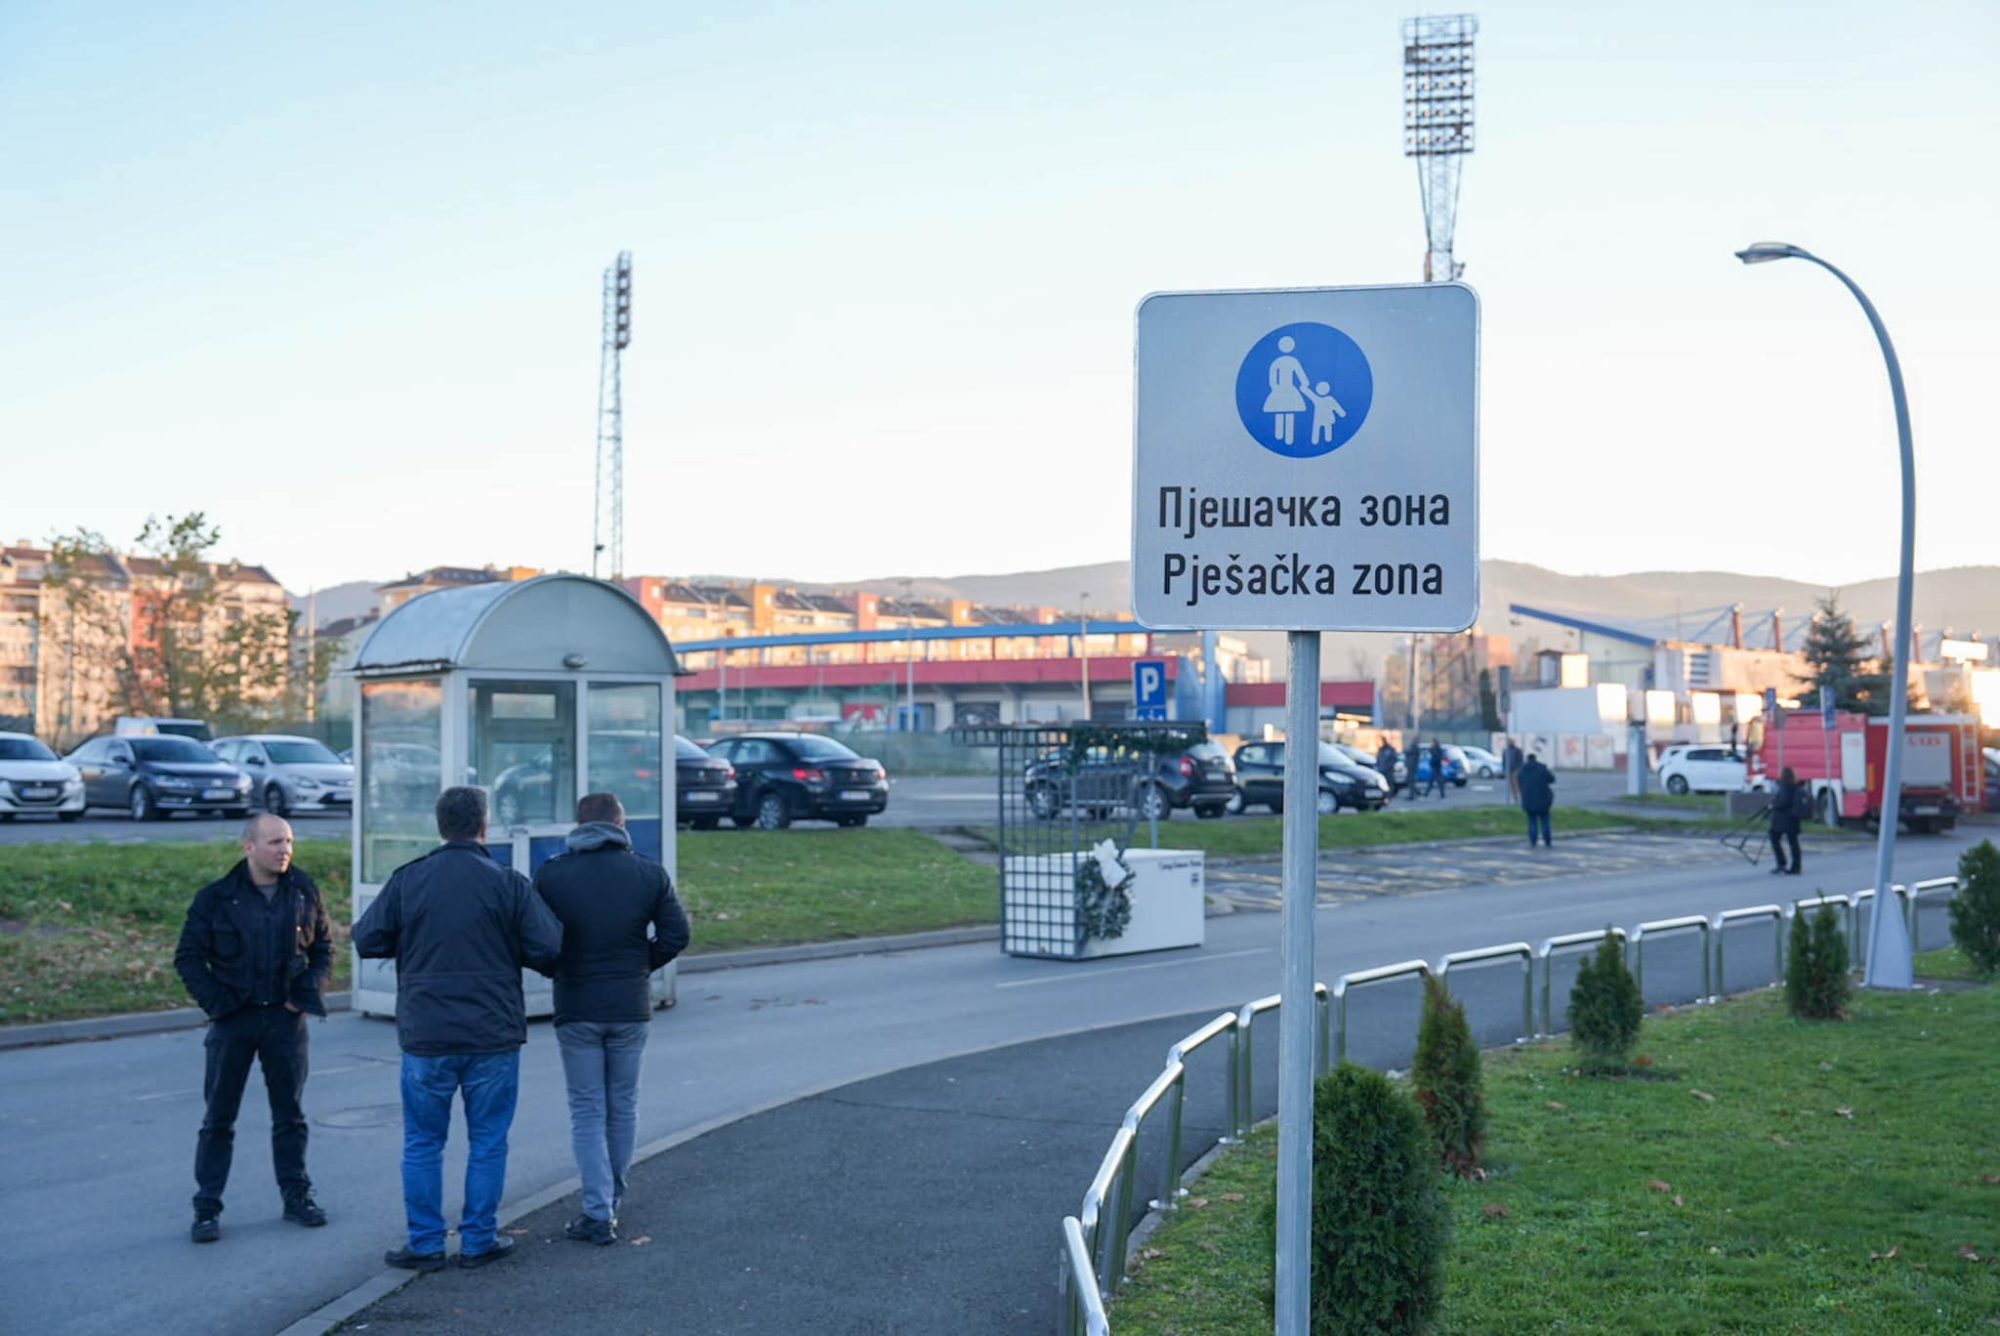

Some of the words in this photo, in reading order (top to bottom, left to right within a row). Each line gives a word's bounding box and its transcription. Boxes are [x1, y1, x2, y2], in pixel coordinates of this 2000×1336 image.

[1159, 486, 1341, 539] Пјешачка
[1359, 494, 1450, 527] зона
[1163, 552, 1335, 607] Pješačka
[1352, 563, 1443, 596] zona
[1141, 667, 1160, 701] P
